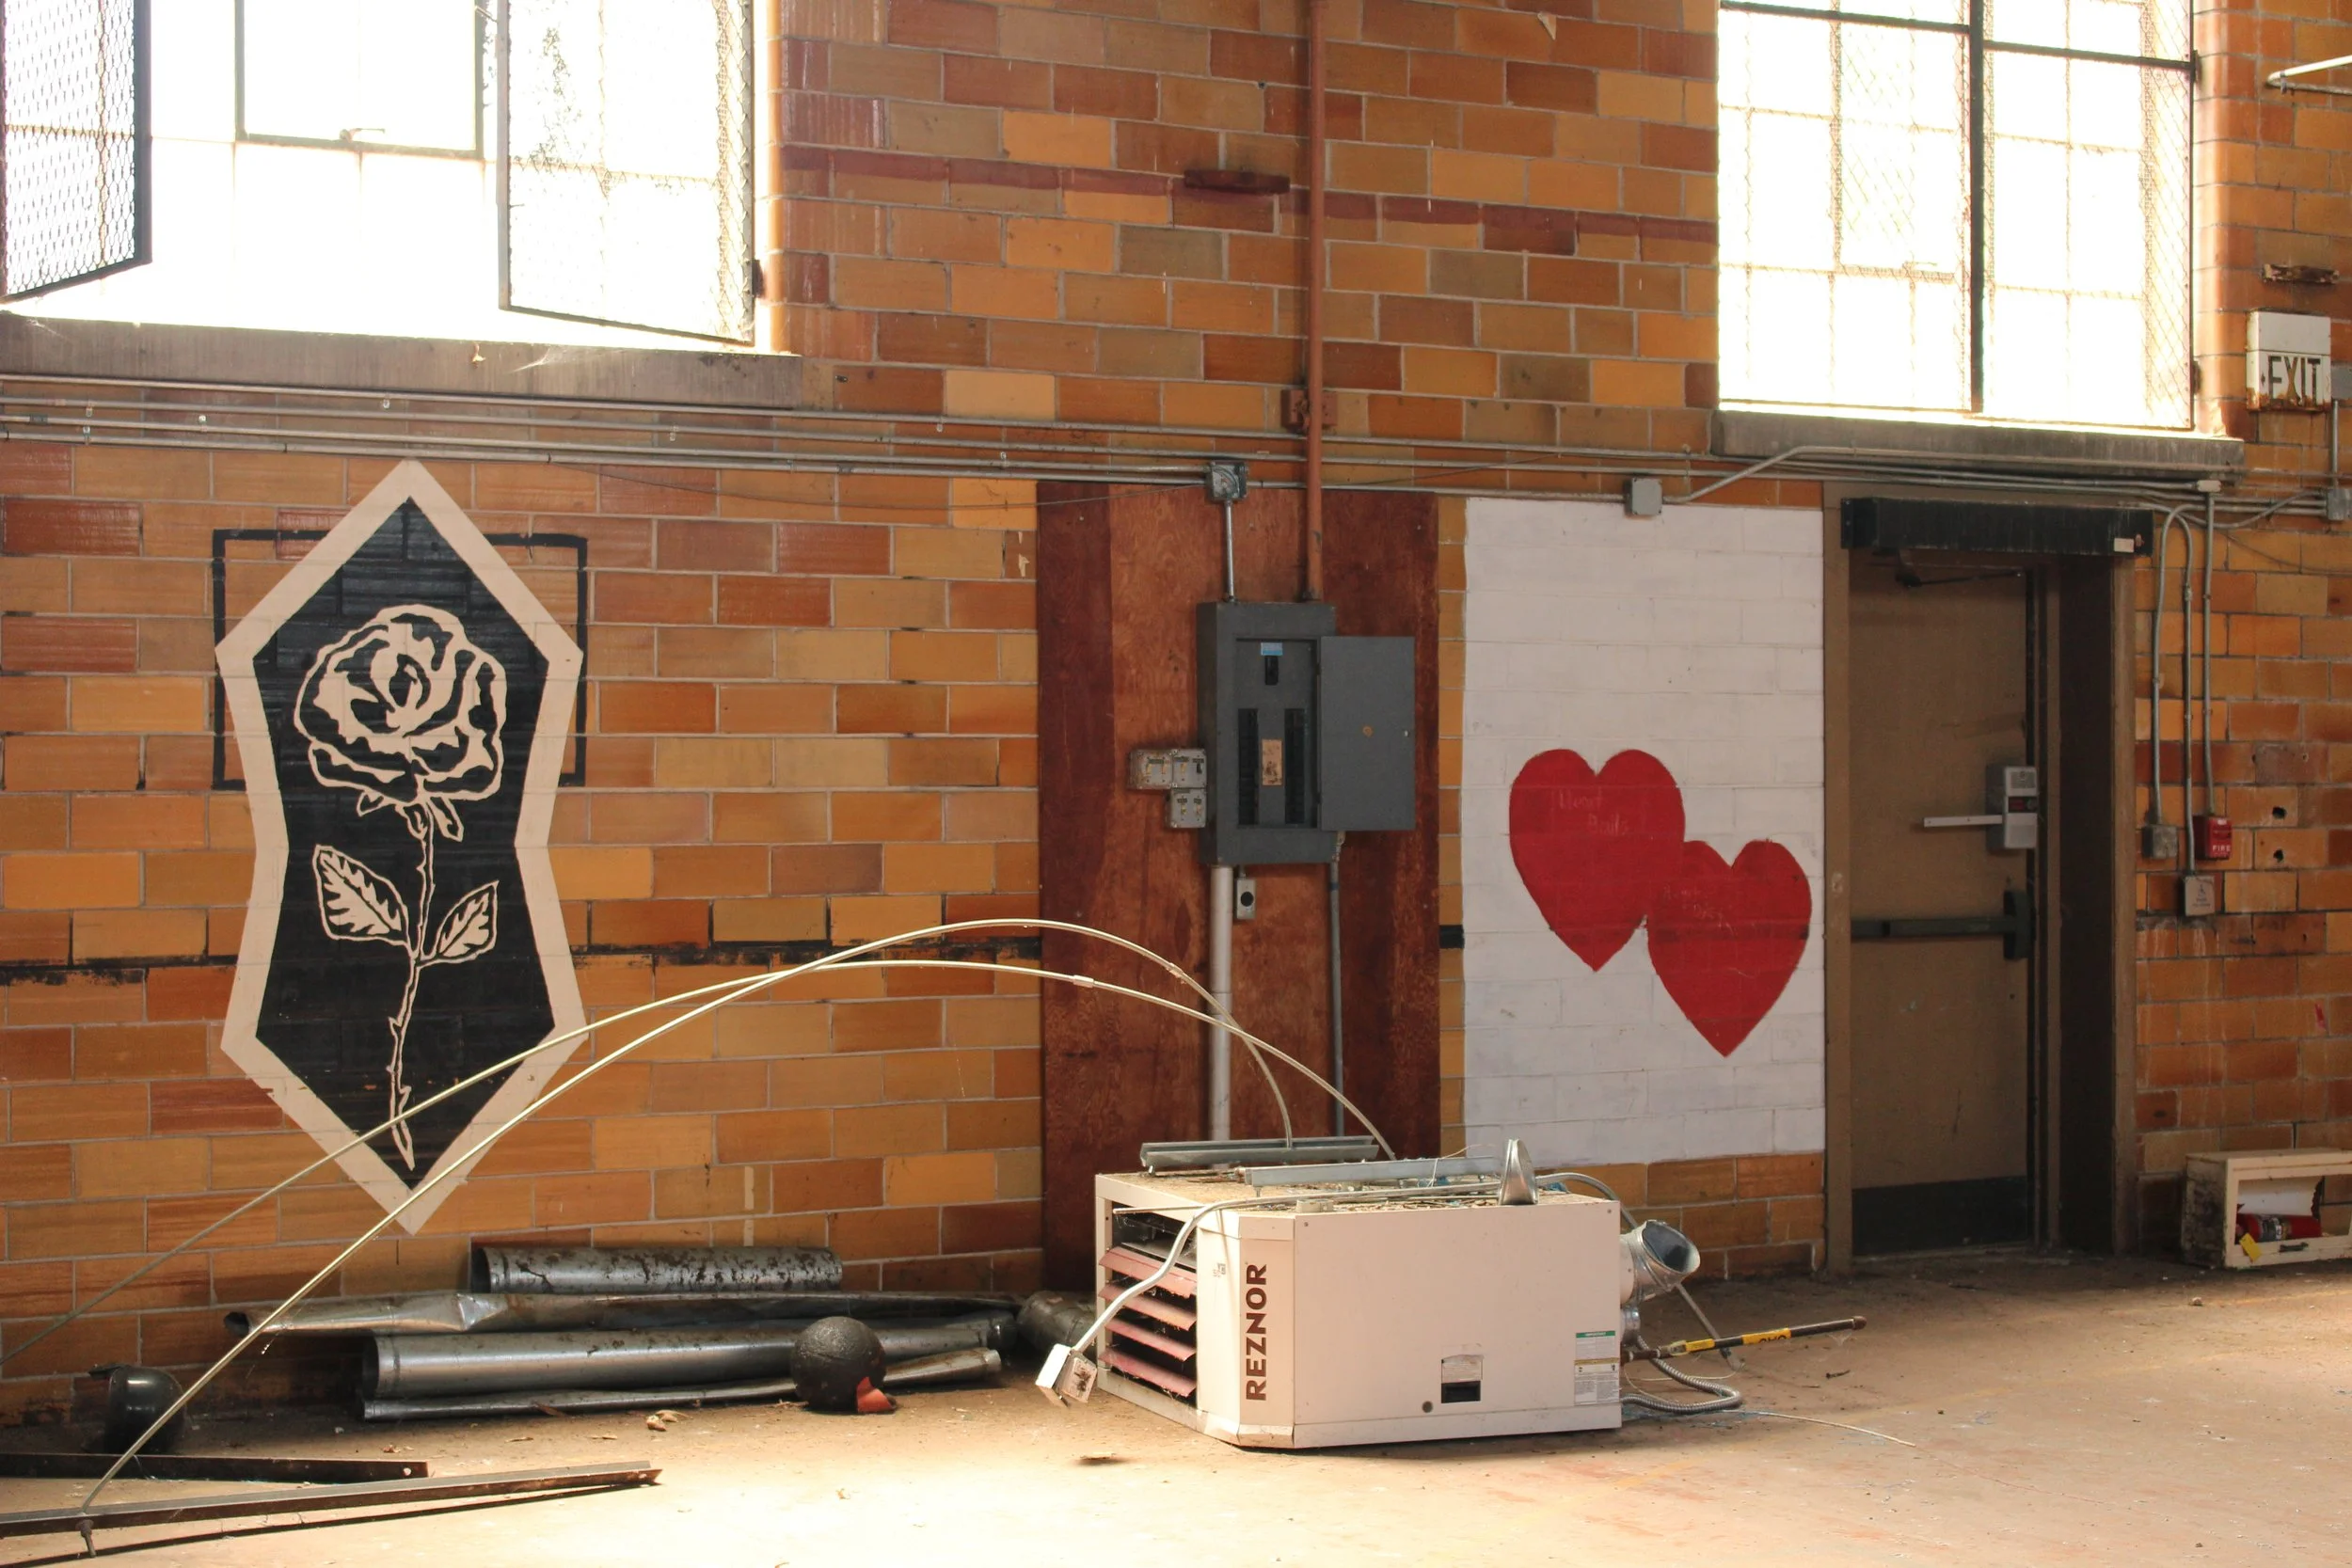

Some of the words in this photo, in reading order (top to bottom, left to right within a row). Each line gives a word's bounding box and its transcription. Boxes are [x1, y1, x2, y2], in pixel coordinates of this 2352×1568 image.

[2267, 356, 2321, 406] EXIT
[2212, 844, 2231, 852] FIRE
[1246, 1263, 1267, 1402] REZNOR
